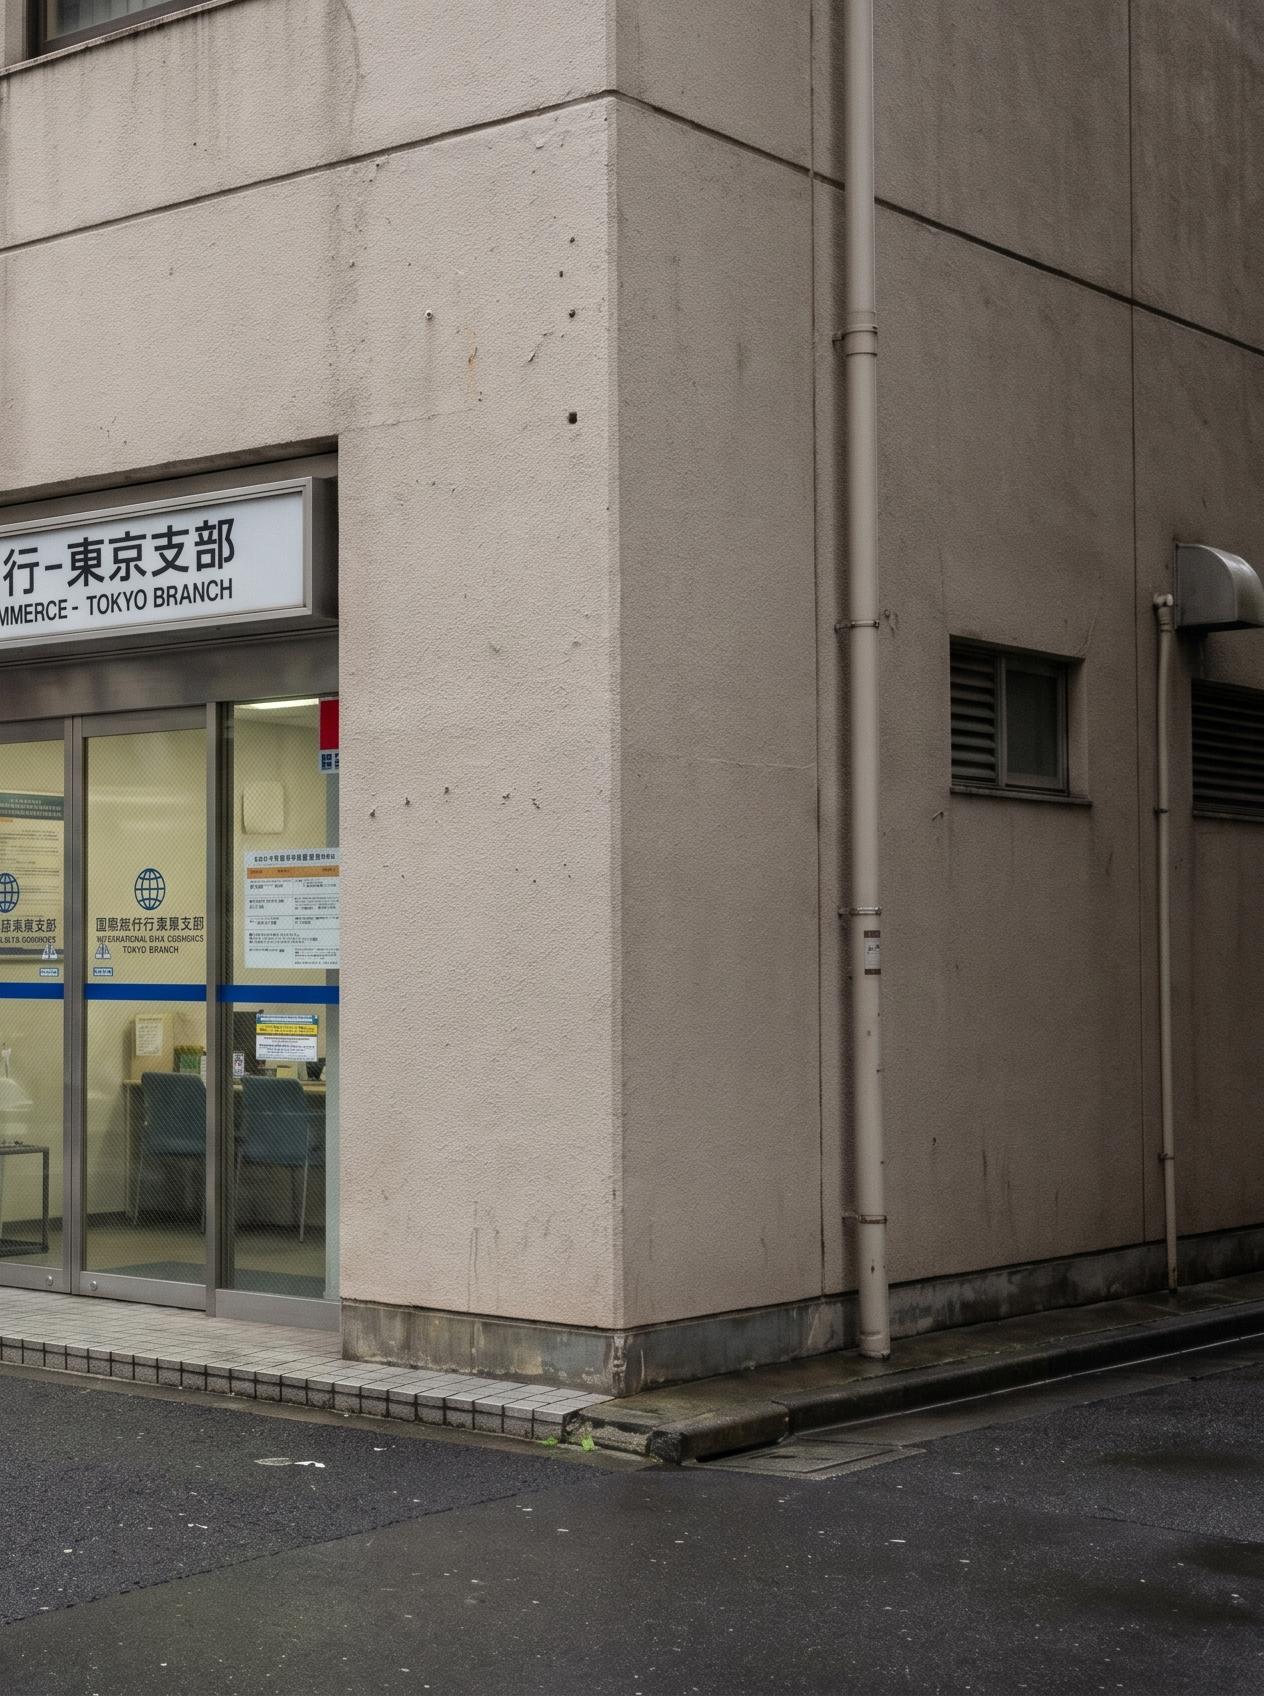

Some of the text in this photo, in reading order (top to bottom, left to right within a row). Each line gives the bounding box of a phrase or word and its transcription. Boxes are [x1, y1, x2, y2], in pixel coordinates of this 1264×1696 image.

[86, 588, 148, 616] TOKYO
[153, 578, 233, 608] BRANCH
[122, 945, 179, 954] TOKYO BRANCH
